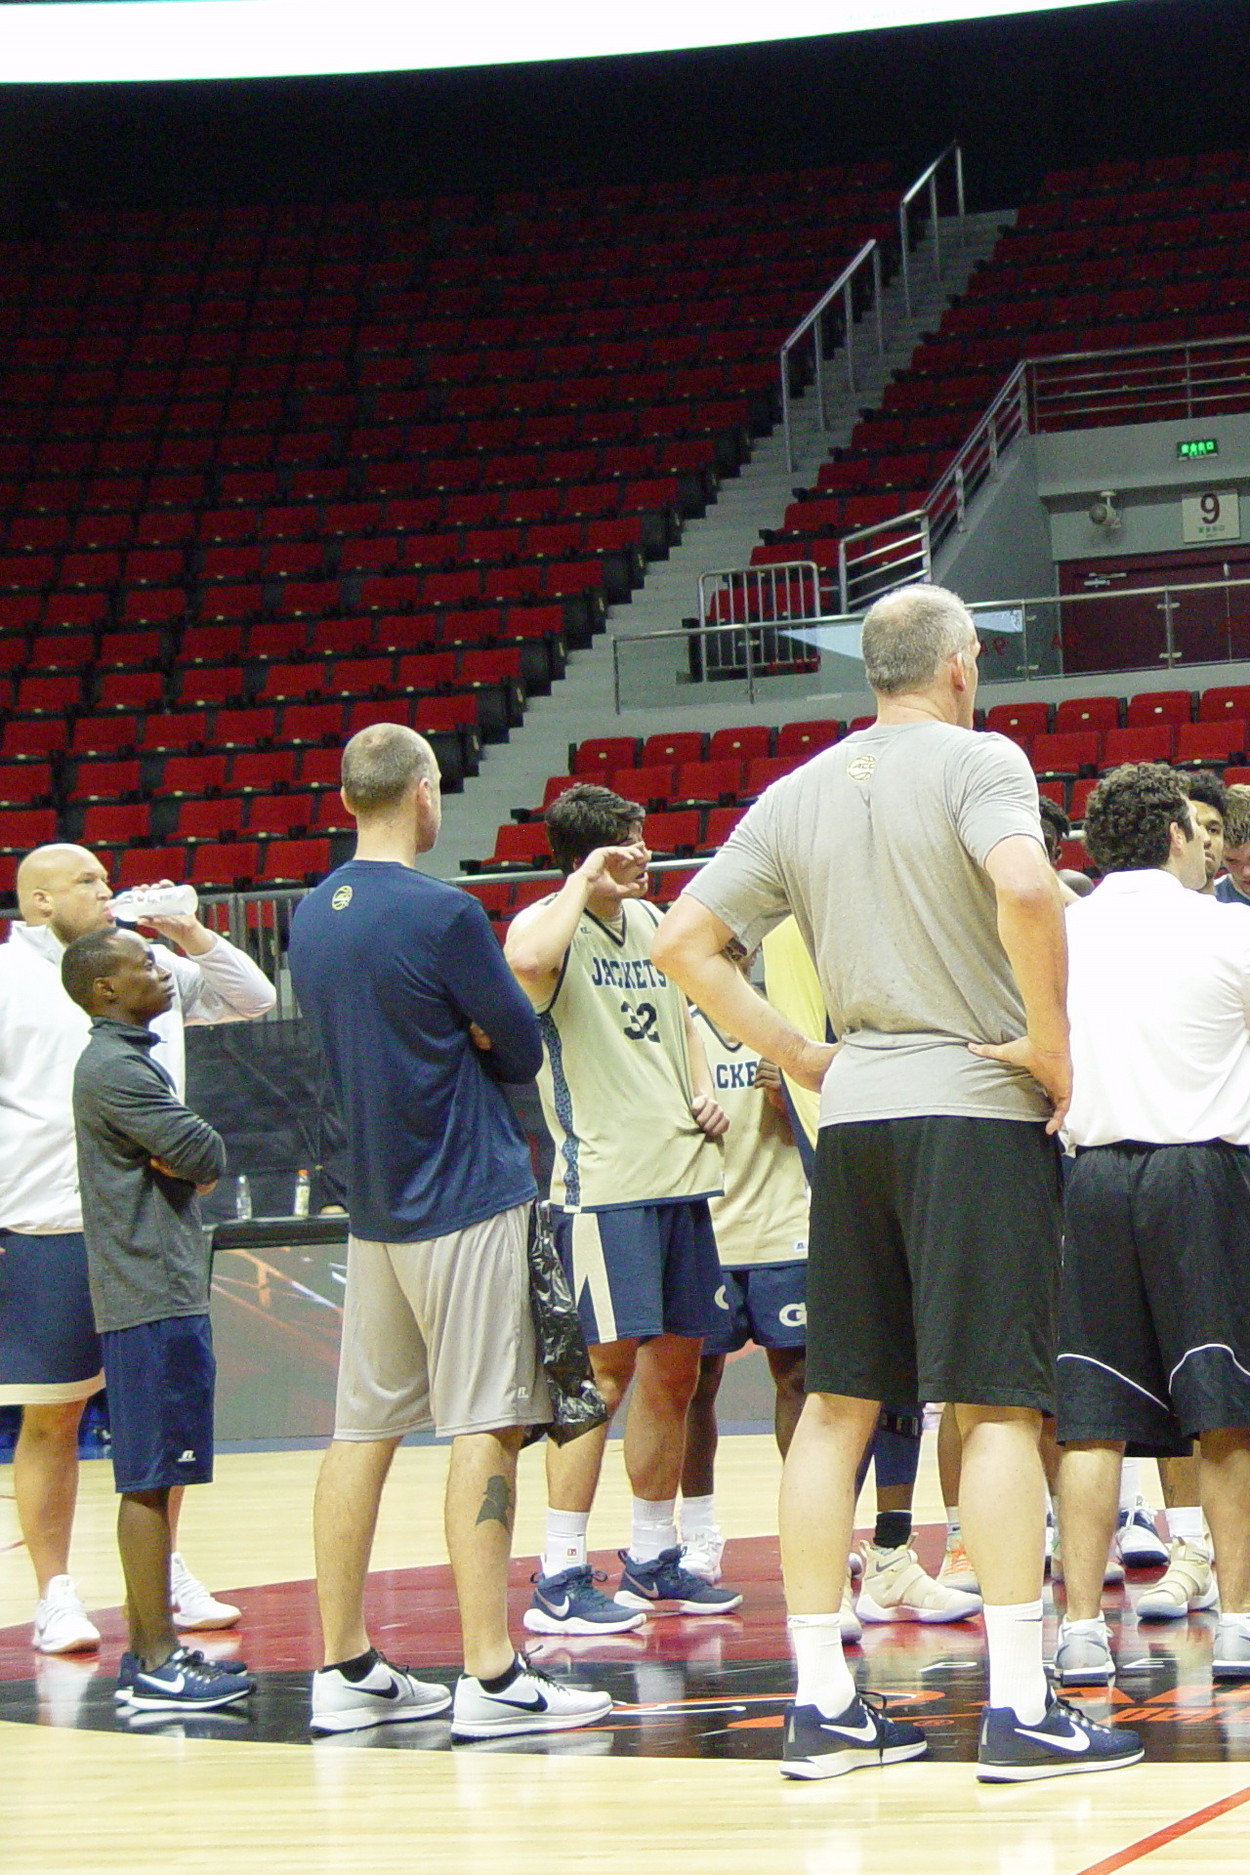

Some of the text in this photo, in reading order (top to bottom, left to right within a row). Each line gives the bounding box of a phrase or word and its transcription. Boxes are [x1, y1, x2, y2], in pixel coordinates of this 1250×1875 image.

[1200, 492, 1220, 525] 9
[591, 956, 667, 989] JACKETS
[620, 1000, 661, 1043] 32
[711, 1060, 757, 1090] CKE
[778, 1301, 808, 1327] G
